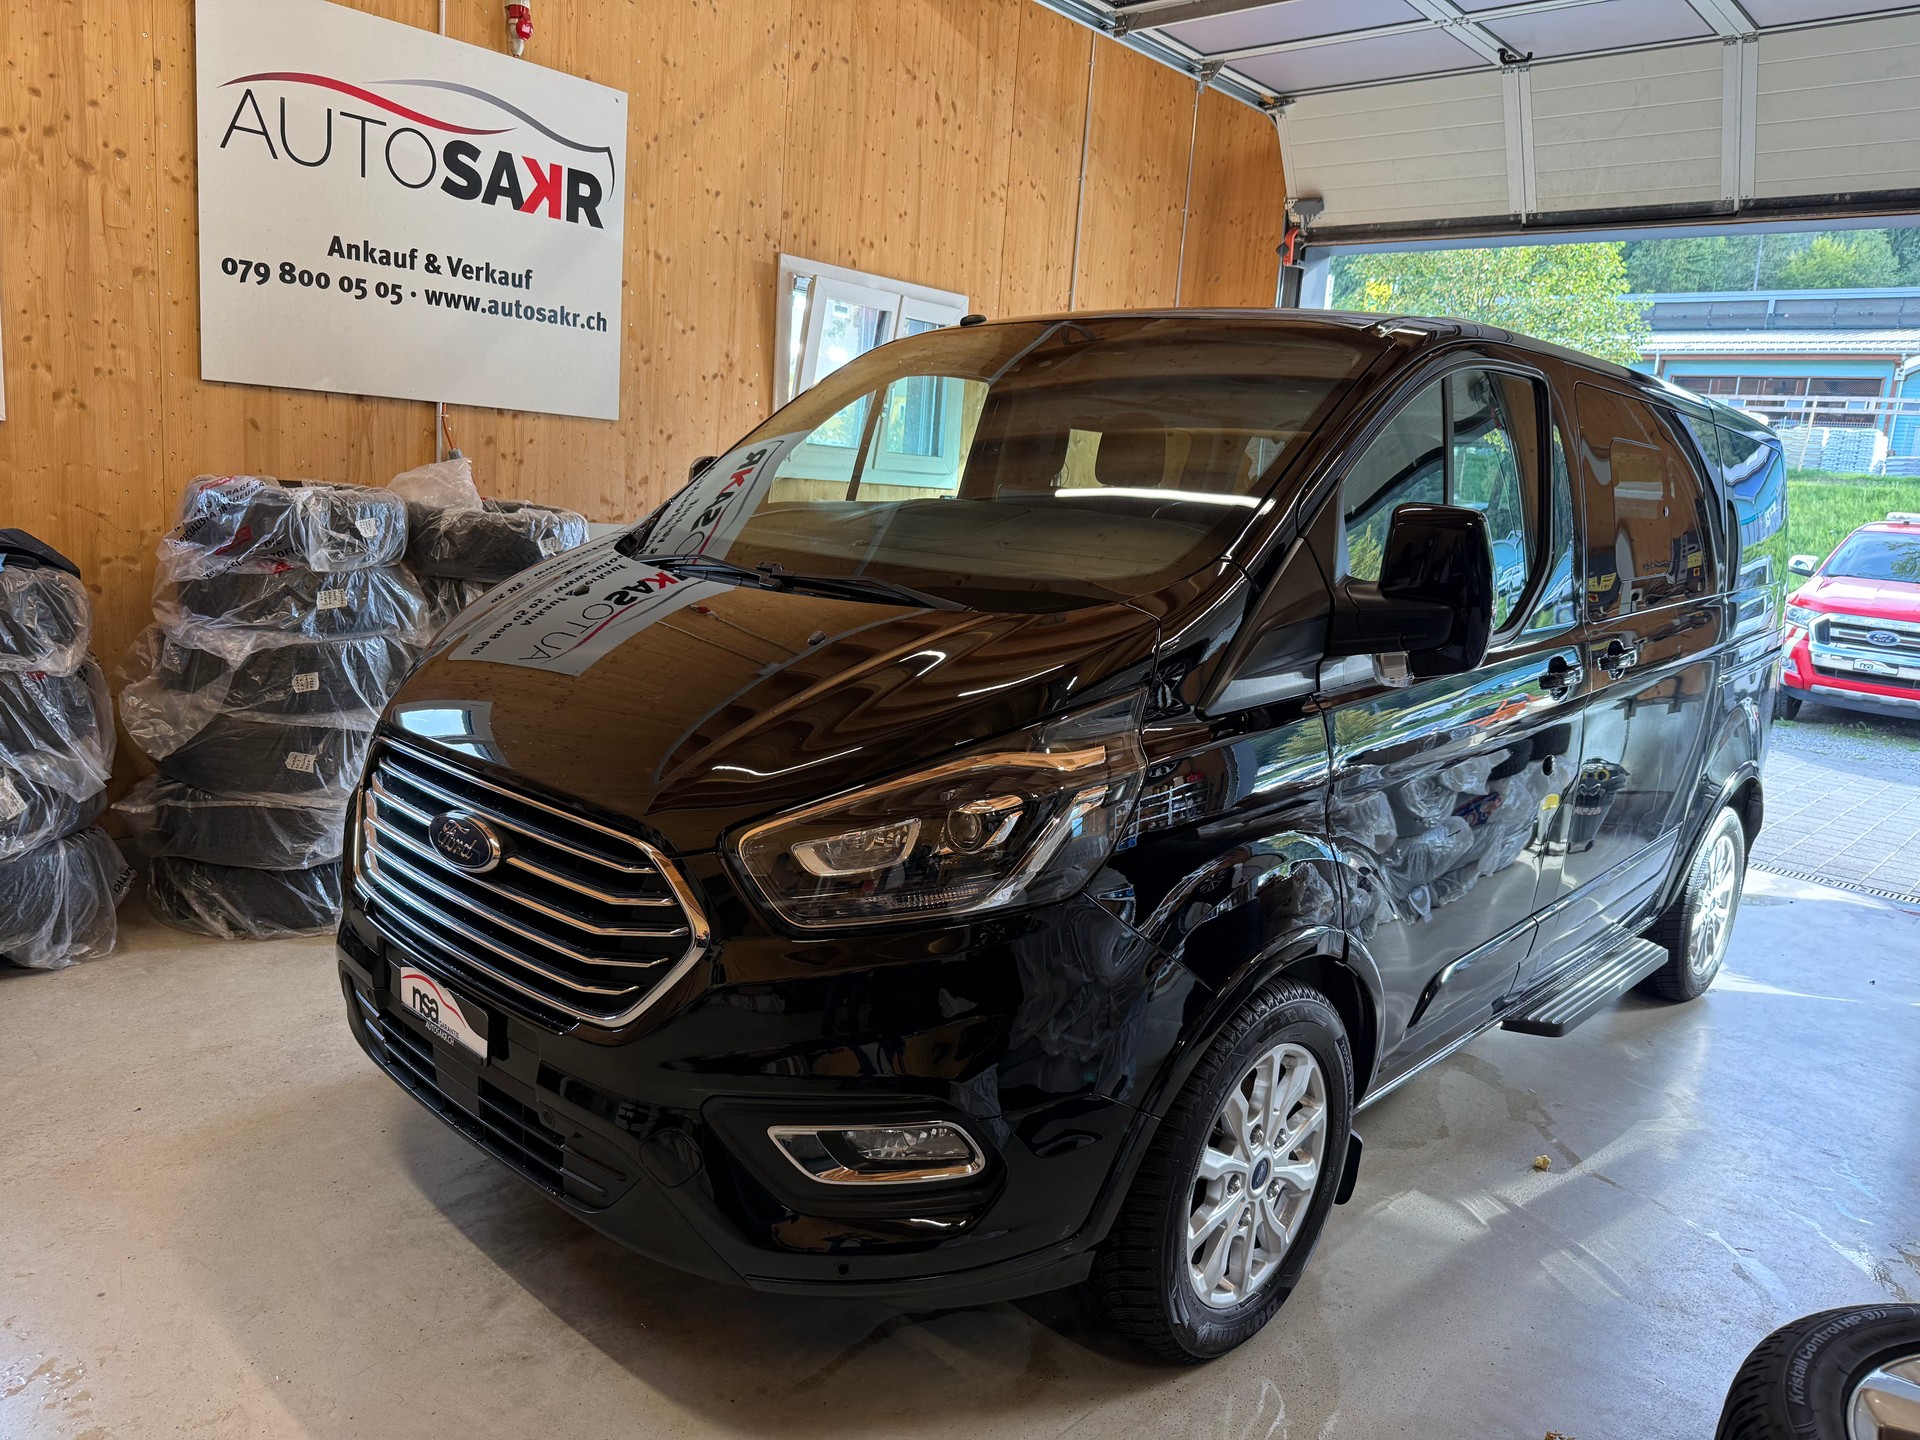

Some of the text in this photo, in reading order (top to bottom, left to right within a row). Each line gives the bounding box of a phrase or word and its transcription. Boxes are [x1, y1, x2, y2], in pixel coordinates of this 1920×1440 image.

[219, 87, 605, 230] AUTOSAKR
[326, 235, 533, 290] Ankauf & Verkauf
[221, 257, 271, 286] 079
[278, 261, 331, 290] 800
[338, 275, 368, 300] 05
[375, 281, 403, 305] 05
[424, 289, 608, 333] www.autosakr.ch
[437, 819, 478, 860] Ford
[412, 985, 439, 1024] nsa
[1797, 1322, 1845, 1360] Control
[1787, 1357, 1809, 1407] Kristall
